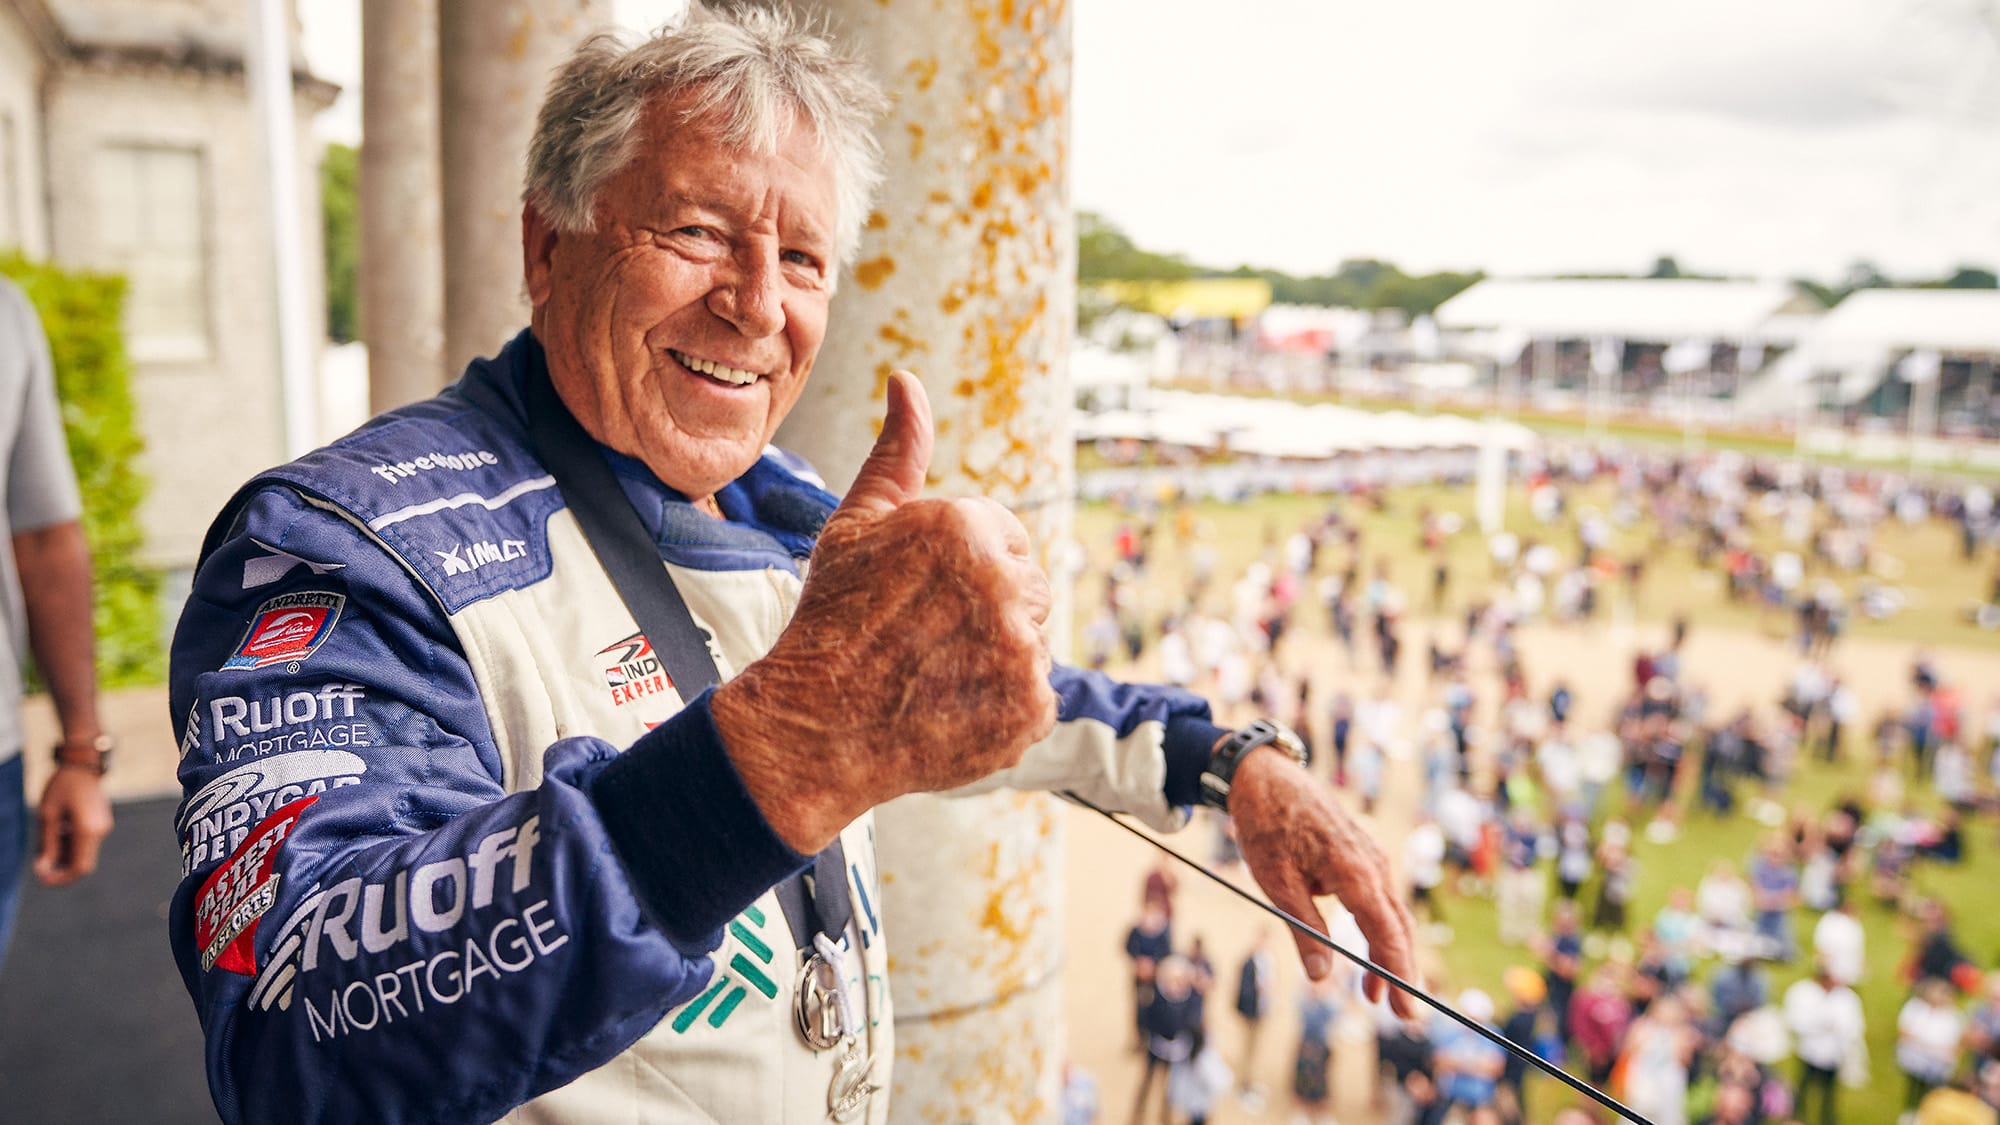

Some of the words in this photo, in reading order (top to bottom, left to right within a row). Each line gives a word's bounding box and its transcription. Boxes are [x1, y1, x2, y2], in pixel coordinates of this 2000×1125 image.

[465, 540, 527, 570] IMACT
[259, 593, 340, 612] ANDRETTI
[210, 683, 366, 742] Ruoff
[216, 723, 370, 764] MORTGAGE
[197, 817, 294, 934] FASTEST
[209, 859, 264, 937] SEAT
[301, 814, 541, 972] Ruoff
[304, 899, 570, 1042] MORTGAGE
